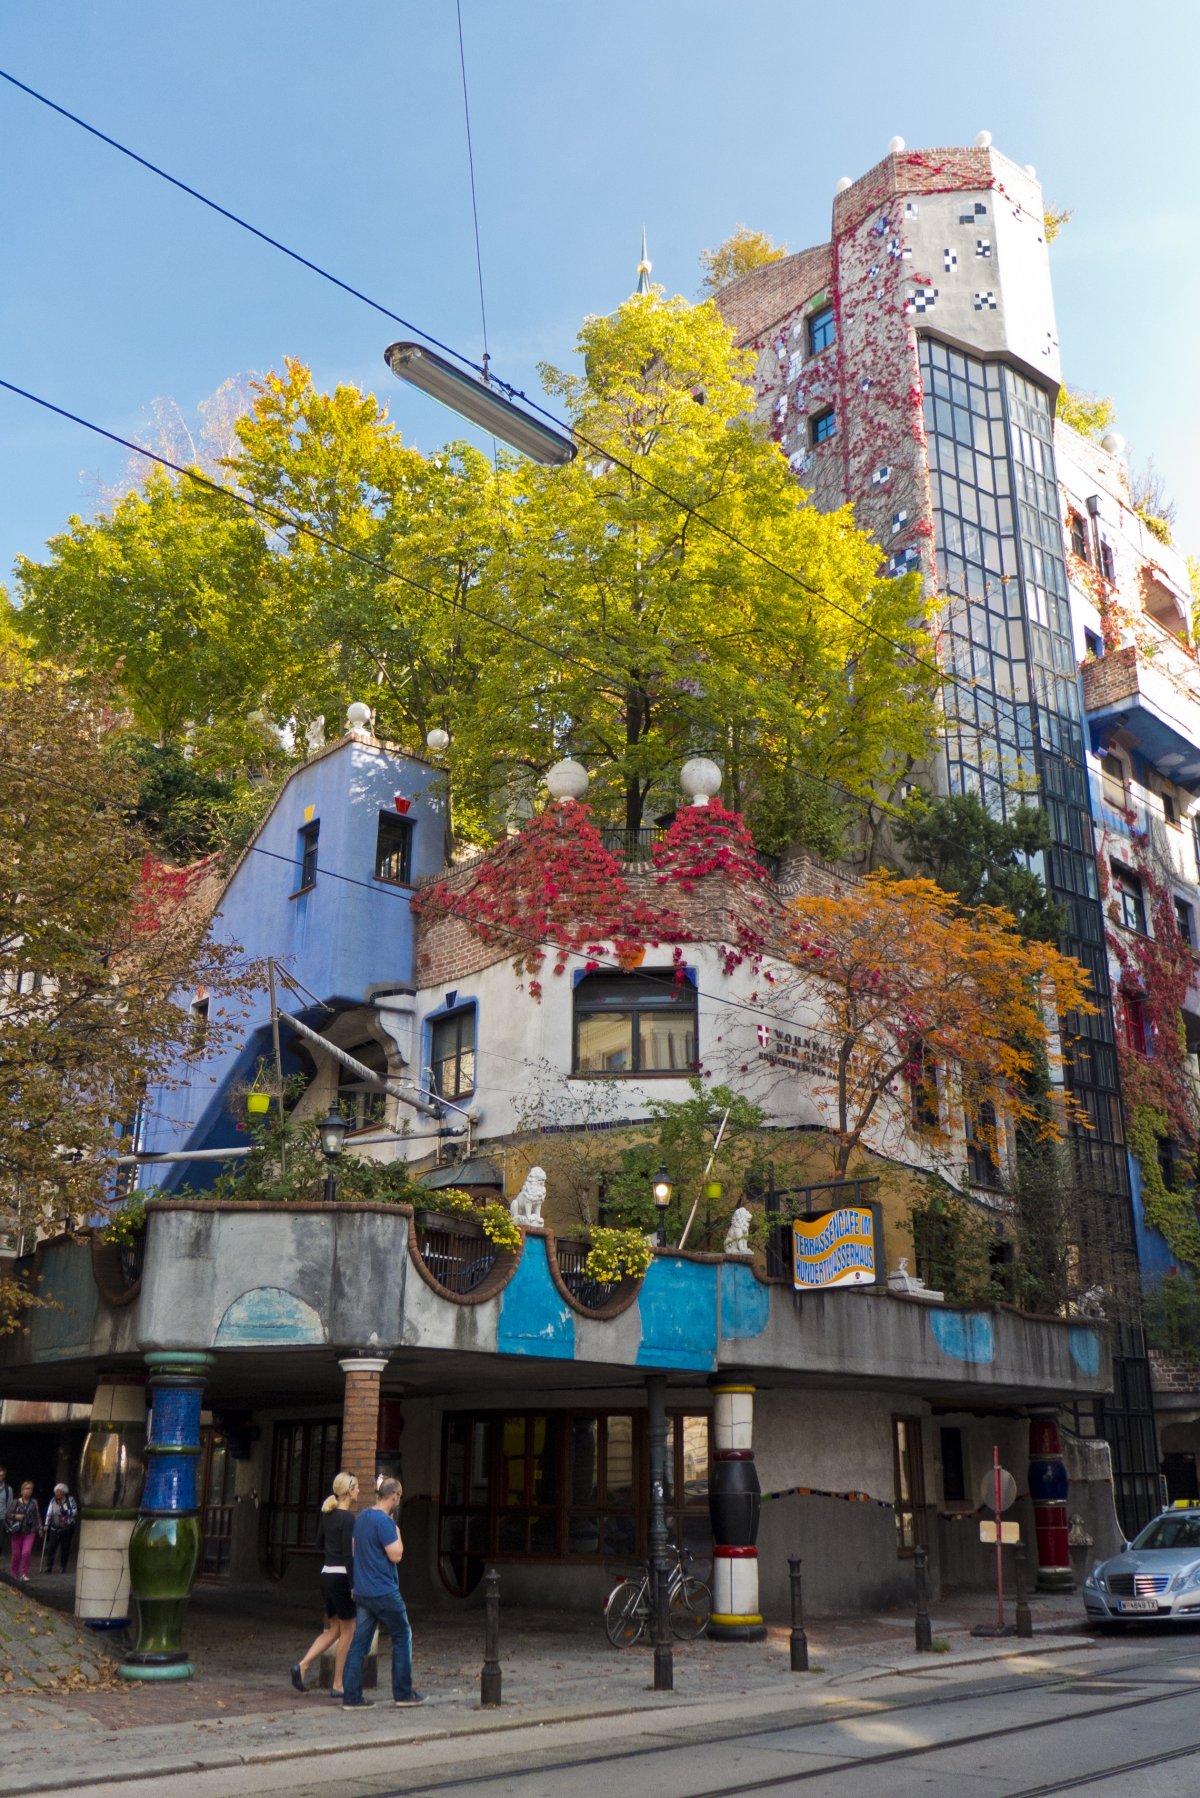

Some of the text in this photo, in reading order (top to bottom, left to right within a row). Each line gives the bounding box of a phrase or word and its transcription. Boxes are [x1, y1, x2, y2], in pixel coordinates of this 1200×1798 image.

[794, 1209, 872, 1256] TERRASSENCAFE IM
[796, 1243, 874, 1284] HUNDERTWASSERHAUS
